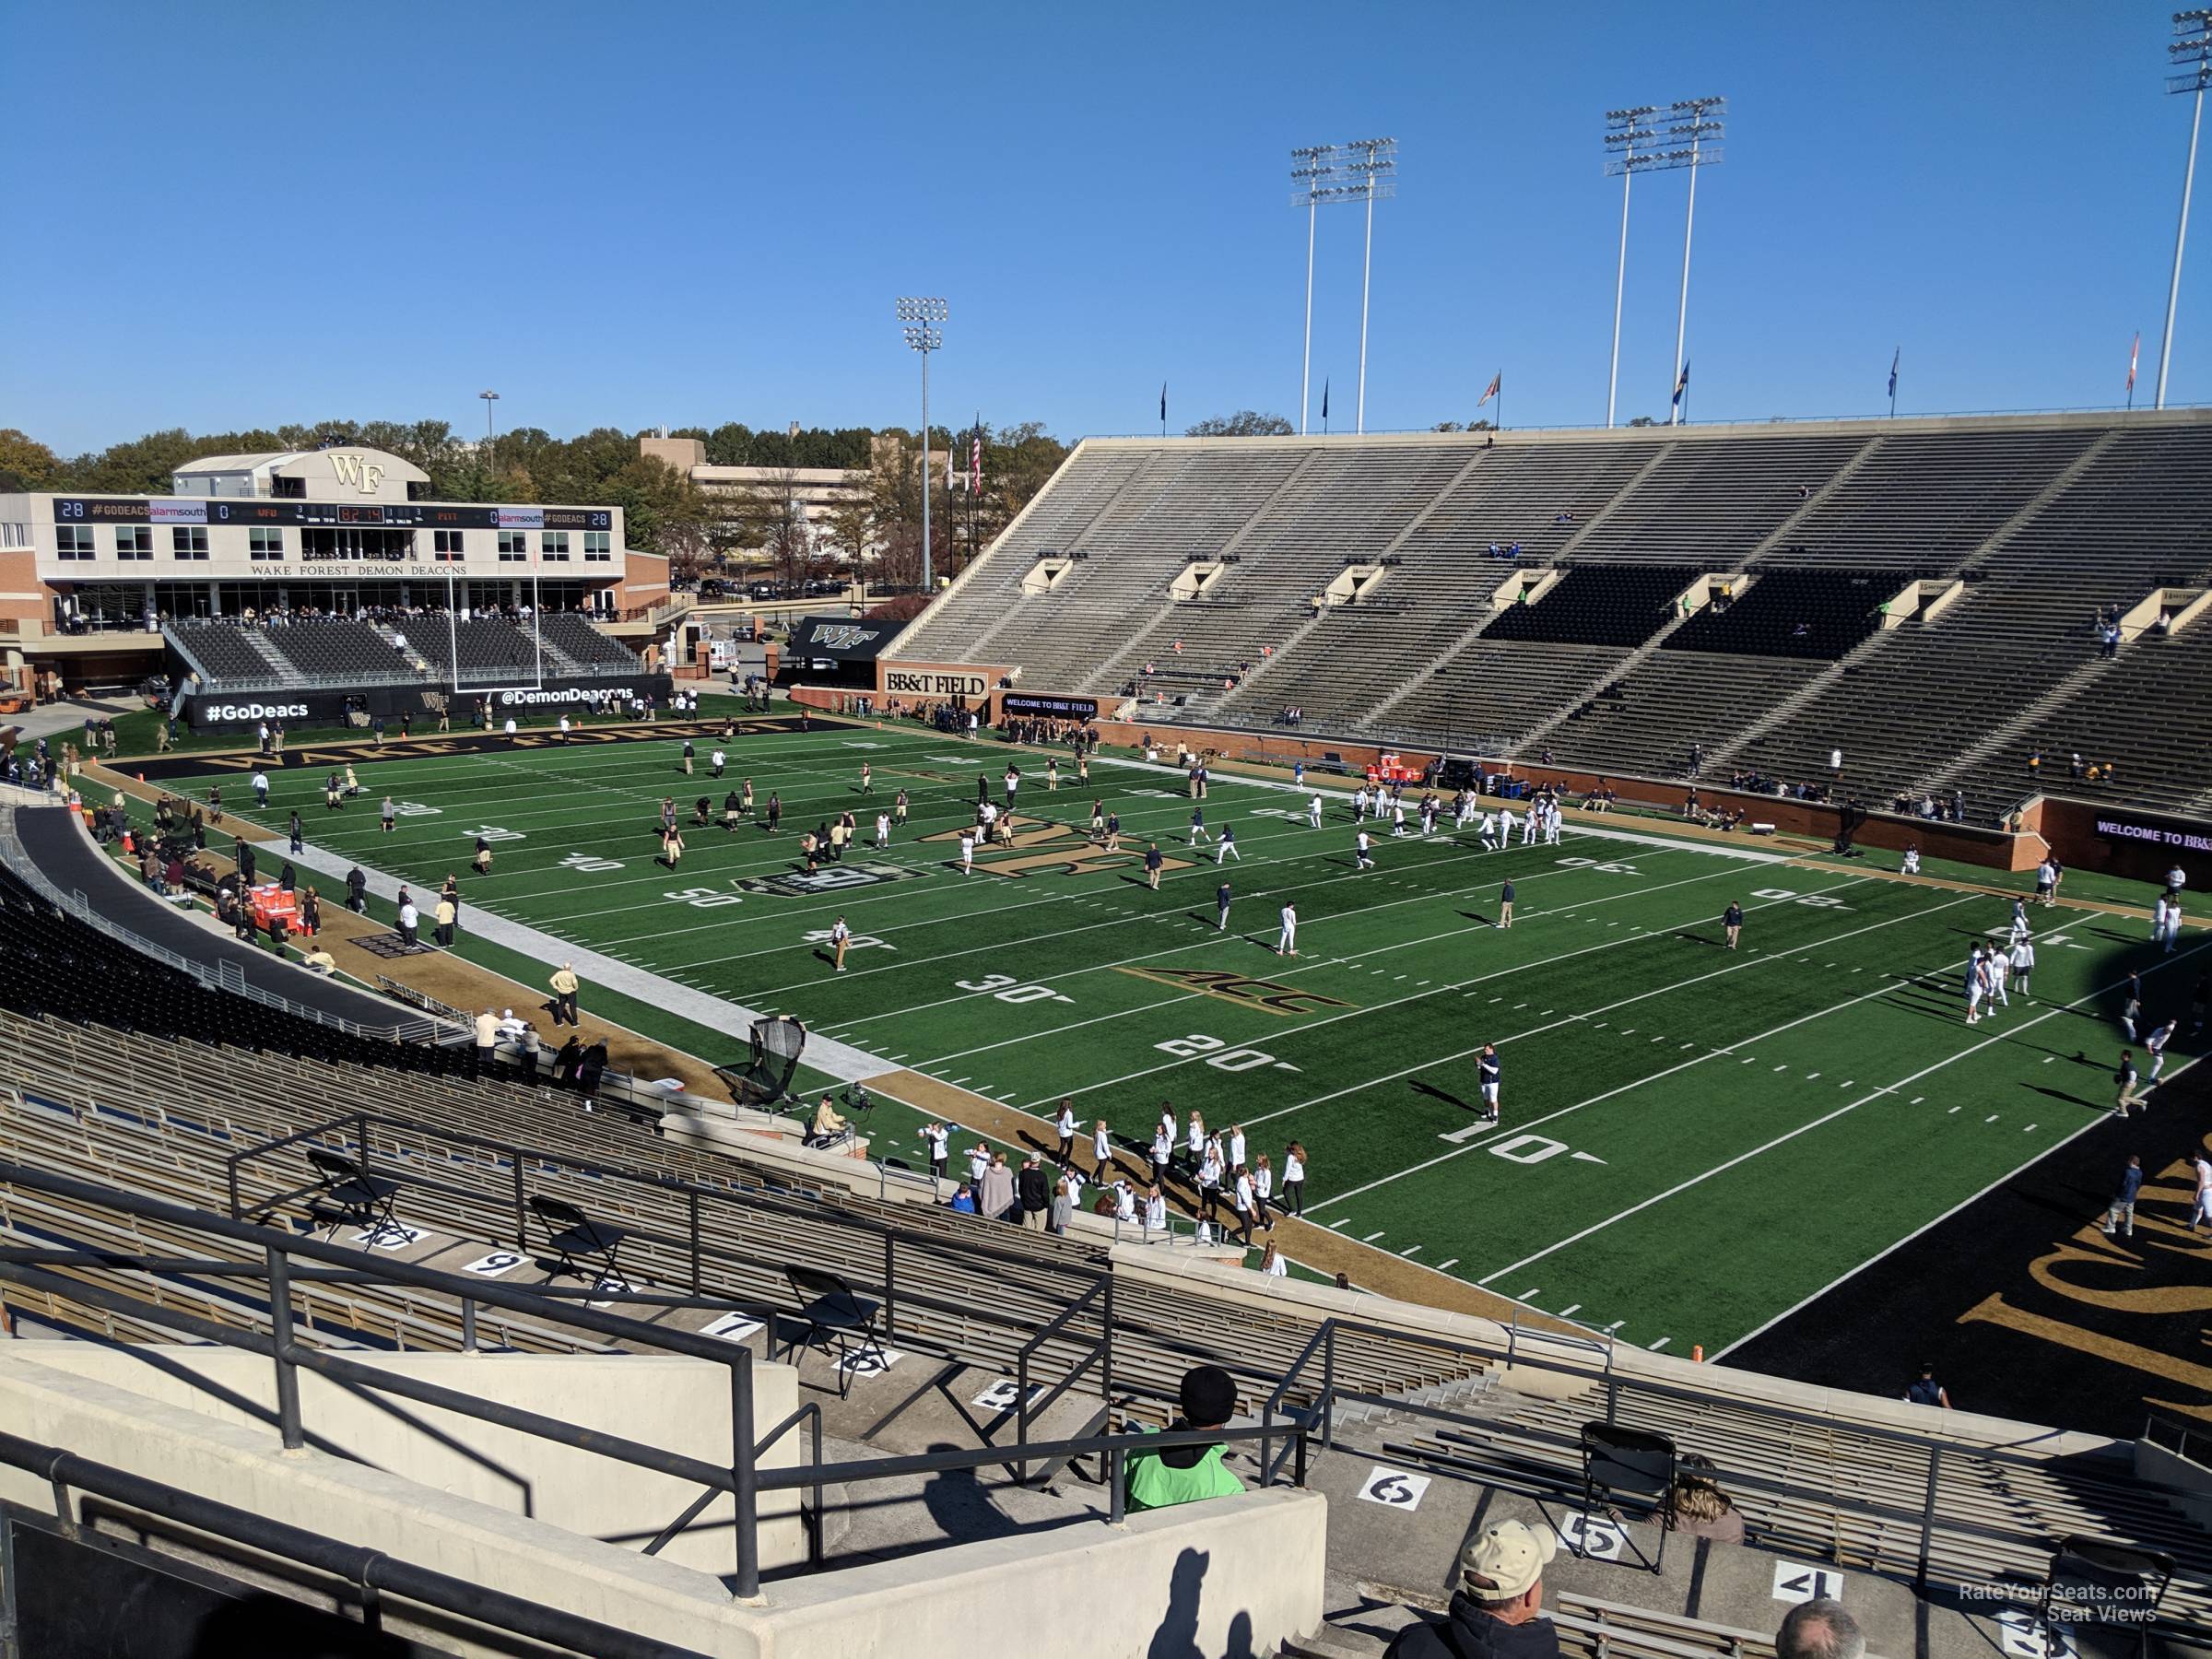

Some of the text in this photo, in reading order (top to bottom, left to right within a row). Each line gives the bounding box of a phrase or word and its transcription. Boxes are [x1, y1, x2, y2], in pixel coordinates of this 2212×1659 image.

[328, 453, 385, 494] WF
[62, 502, 84, 517] 28
[92, 504, 150, 516] #GODEACS
[149, 507, 207, 517] alarmsouth
[499, 513, 544, 523] alarmsouth
[544, 513, 586, 524] #GODEACS
[592, 513, 607, 525] 28
[251, 566, 467, 576] WAKE FOREST DEMON DEACONS
[808, 624, 880, 649] WF
[887, 673, 985, 696] BB&T FIELD
[206, 703, 309, 722] #GoDeacs
[421, 692, 449, 712] WF
[1006, 699, 1041, 709] WELCOME
[1053, 701, 1070, 711] BB&T
[1071, 703, 1095, 712] FIELD
[197, 741, 481, 771] WAKE
[1382, 769, 1390, 778] G
[2097, 820, 2161, 841] WELCOME
[2163, 832, 2182, 845] TO
[664, 888, 743, 908] 50
[955, 974, 1057, 1004] 30
[1132, 967, 1360, 1014] ACC
[1153, 1034, 1277, 1072] 20
[1438, 1121, 1570, 1164] 10
[1370, 1475, 1414, 1503] 6
[1571, 1516, 1616, 1553] 5
[1780, 1570, 1832, 1601] 4
